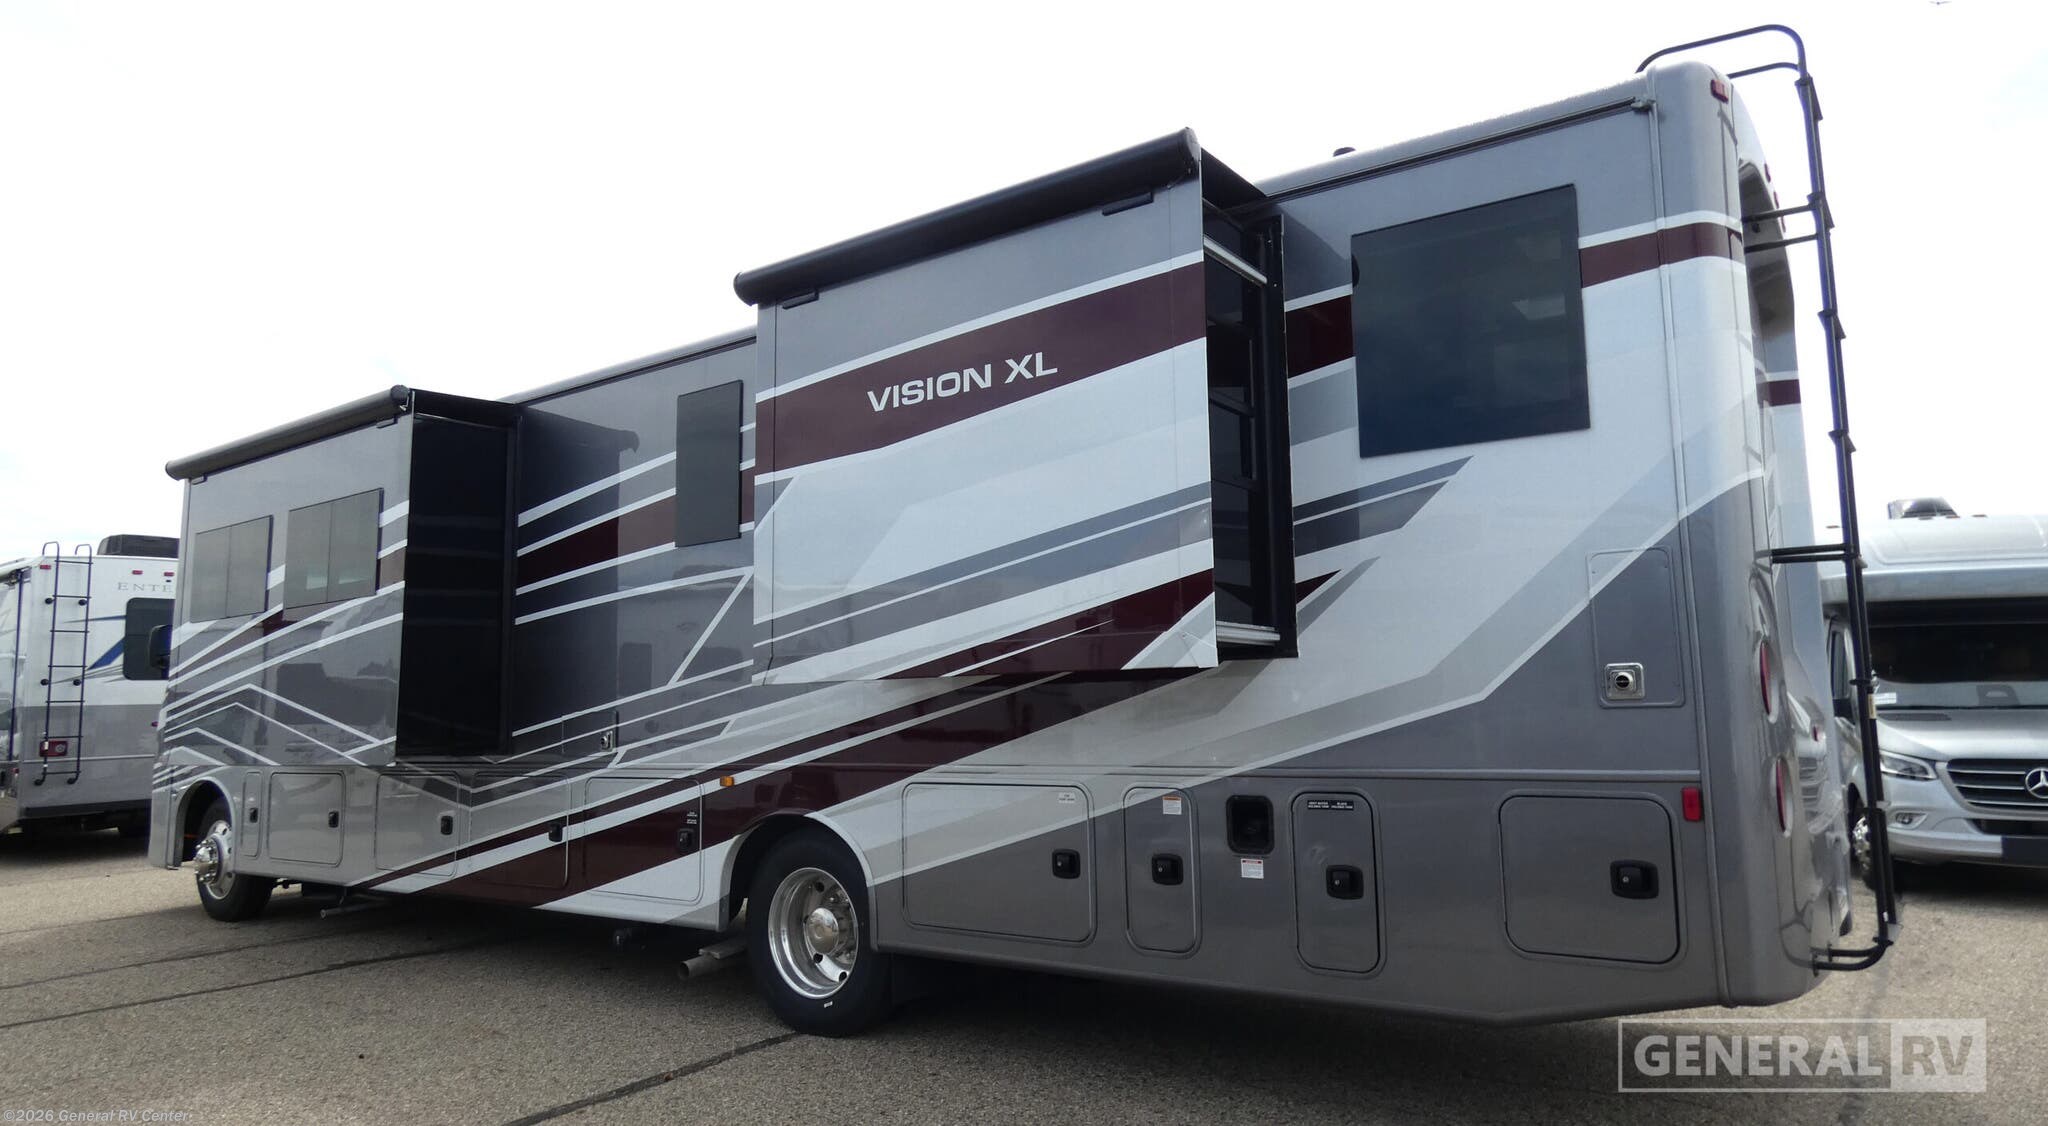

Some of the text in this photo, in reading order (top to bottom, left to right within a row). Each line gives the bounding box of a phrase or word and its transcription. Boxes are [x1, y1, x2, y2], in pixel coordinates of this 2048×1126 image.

[867, 351, 1058, 412] VISION XL
[117, 582, 173, 593] ENTE
